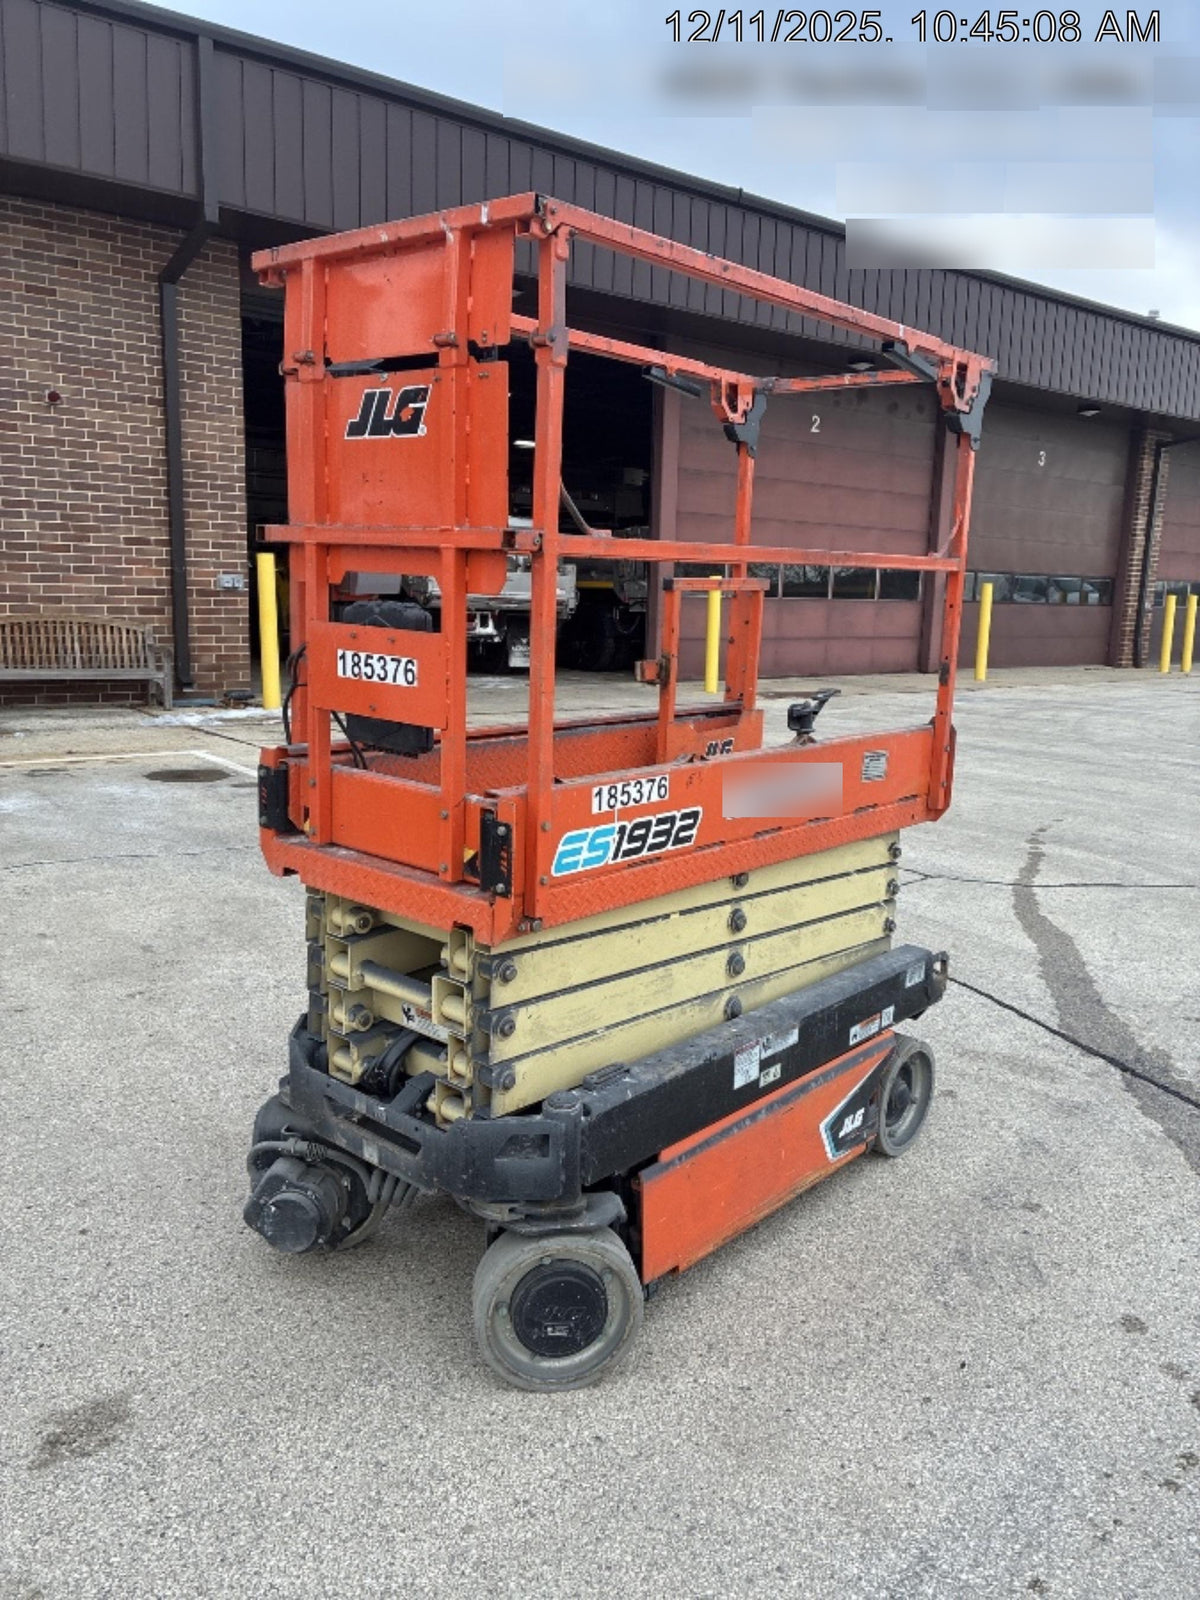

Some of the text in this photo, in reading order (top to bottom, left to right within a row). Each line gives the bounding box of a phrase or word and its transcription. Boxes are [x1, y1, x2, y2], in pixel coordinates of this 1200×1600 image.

[344, 384, 430, 439] JLG
[810, 414, 821, 433] 2
[1038, 451, 1047, 467] 3
[338, 650, 416, 686] 185376
[594, 775, 668, 812] 185376
[551, 807, 703, 877] ES1932
[838, 1106, 866, 1139] JLG
